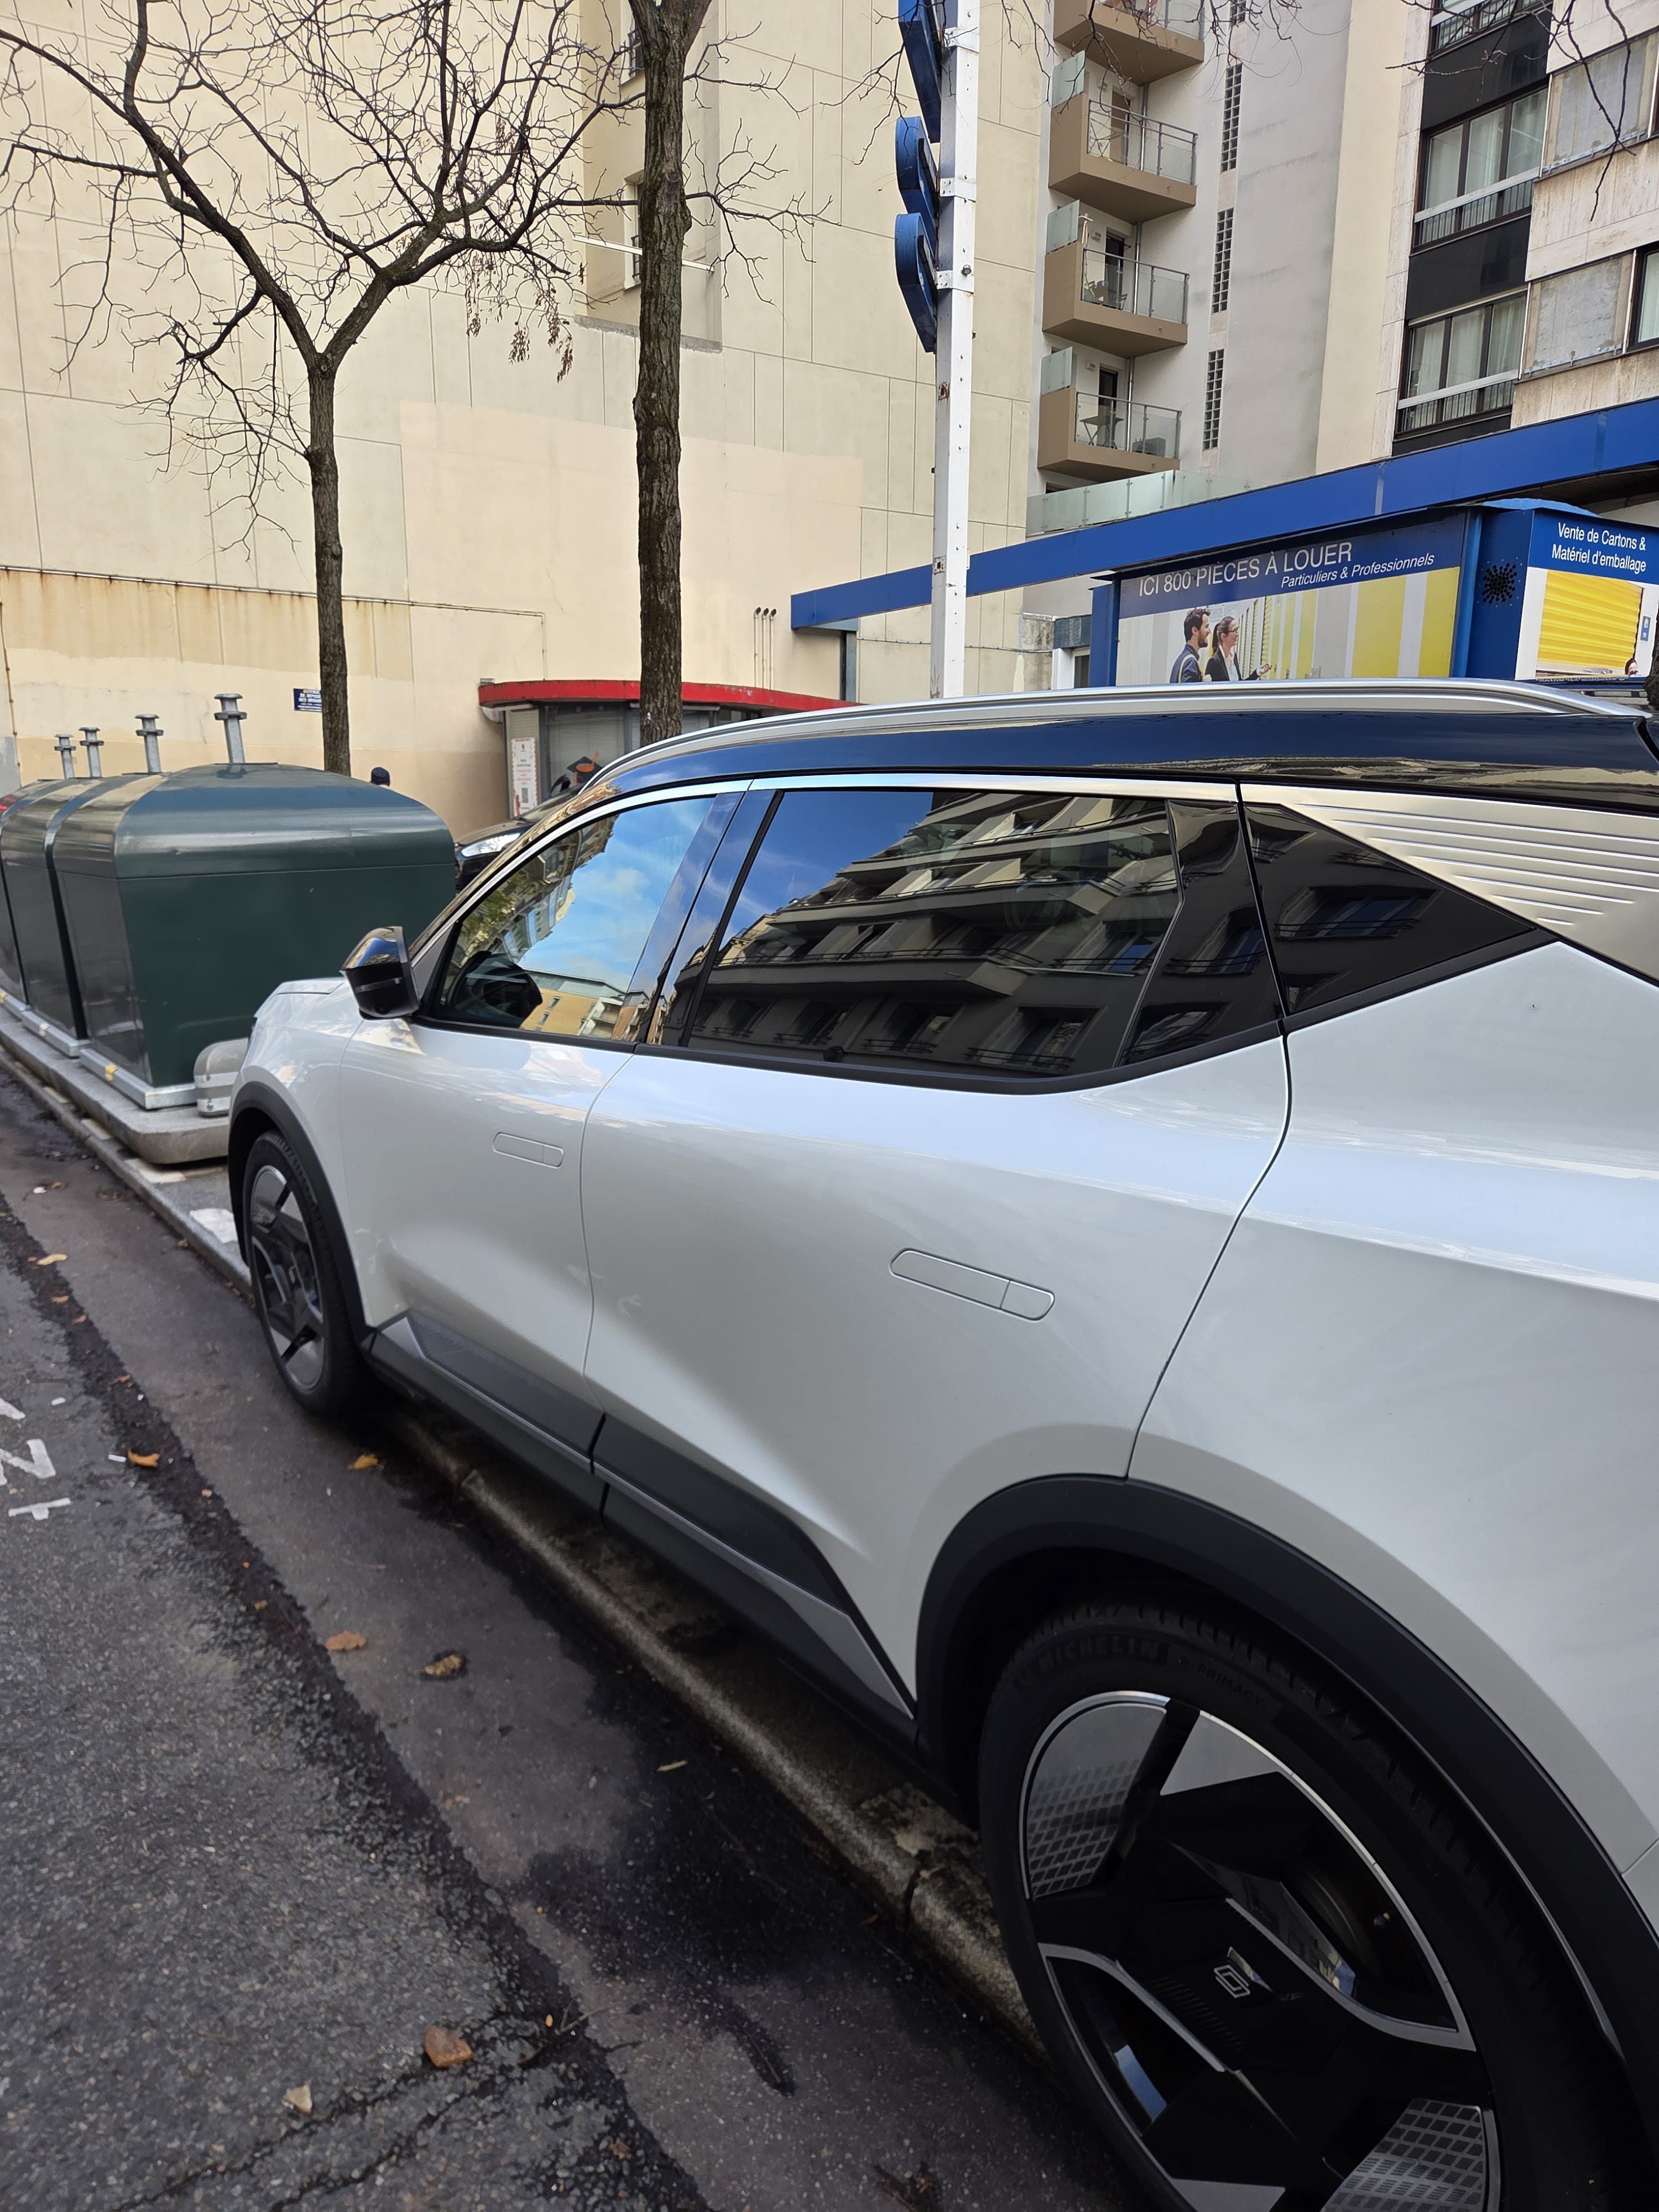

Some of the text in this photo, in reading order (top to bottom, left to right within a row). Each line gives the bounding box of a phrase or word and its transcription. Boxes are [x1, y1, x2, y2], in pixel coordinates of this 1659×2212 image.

[1558, 522, 1646, 551] Vente de Cartons &
[1139, 541, 1353, 597] ICI 800 PIÈCES À LOUER
[1281, 553, 1434, 588] Particuliers & Professionnels
[1552, 544, 1646, 575] Matériel d'emballage
[1037, 1634, 1160, 1670] MICHELIN
